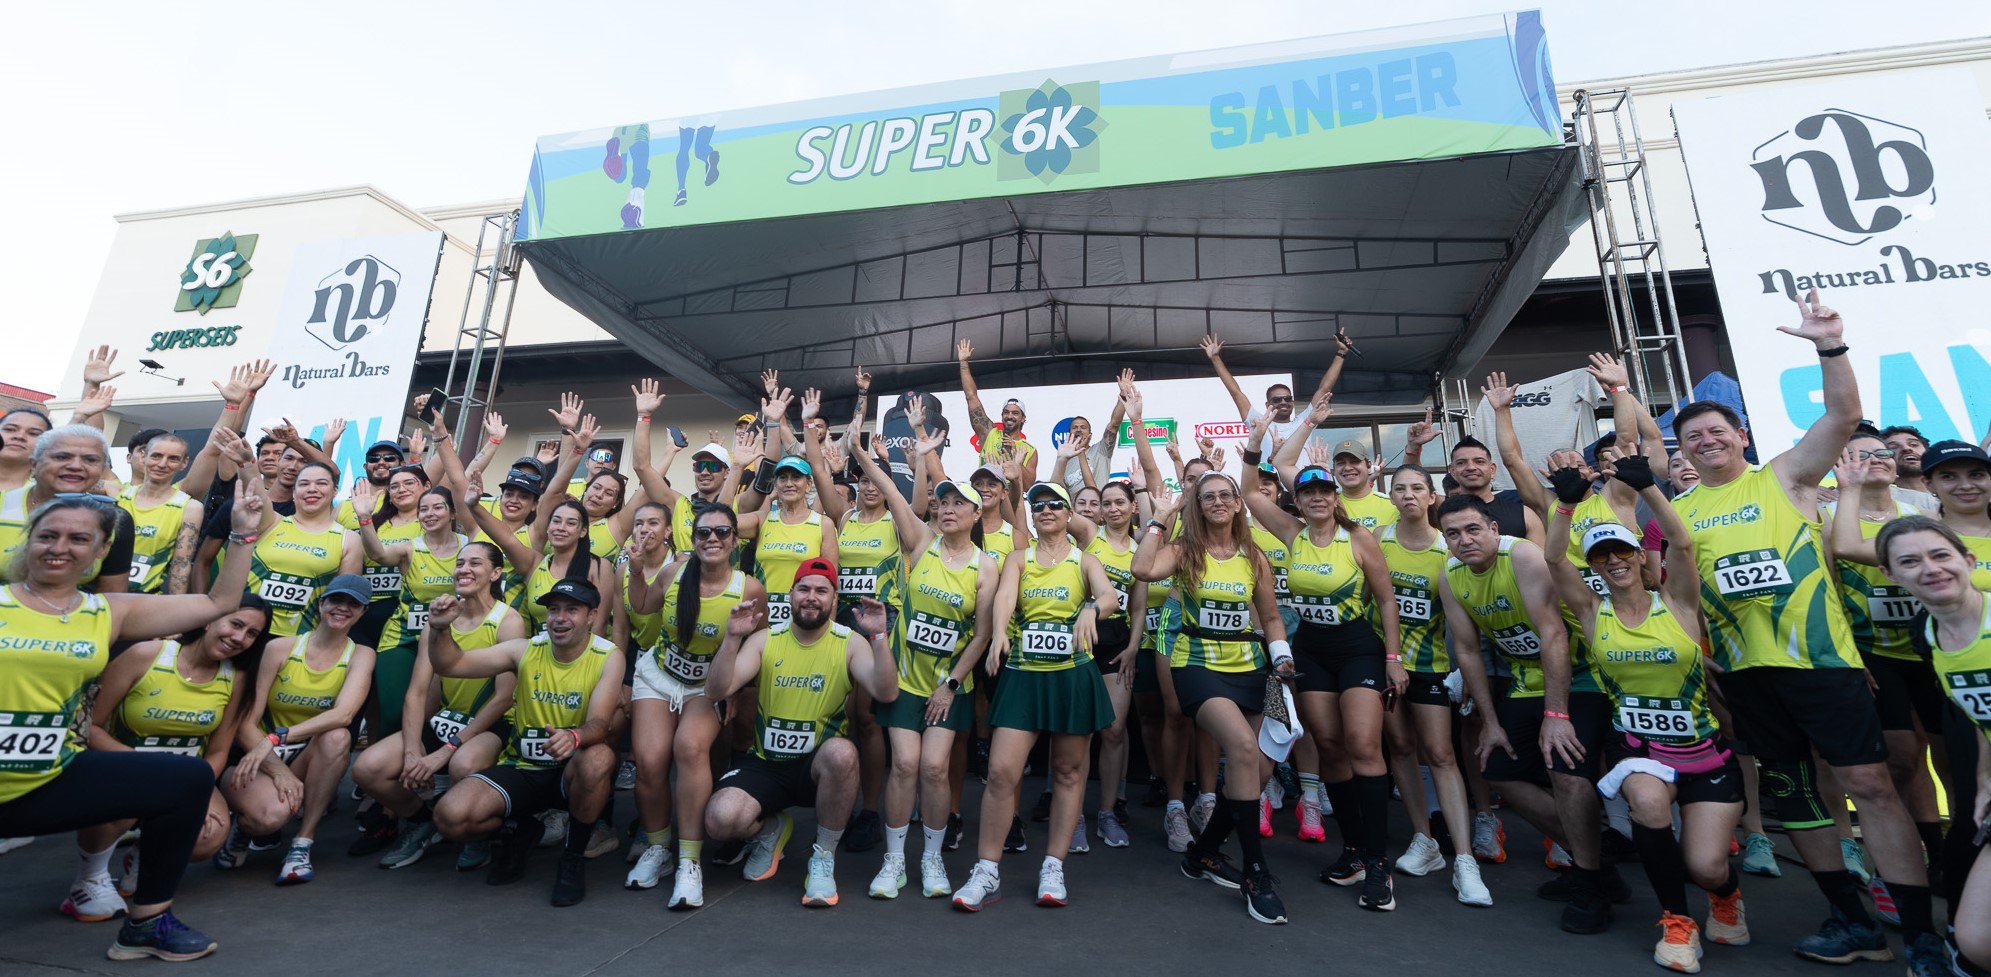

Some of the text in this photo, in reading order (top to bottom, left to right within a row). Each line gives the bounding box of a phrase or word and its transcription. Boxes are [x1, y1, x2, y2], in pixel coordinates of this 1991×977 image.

[1209, 50, 1459, 151] SANBER
[787, 104, 1082, 186] SUPER 6K
[182, 251, 237, 291] S6
[145, 324, 243, 352] SUPERSEIS
[1127, 426, 1168, 439] Cpesino
[1693, 506, 1757, 533] SUPER 6K
[272, 541, 312, 555] SUPER
[762, 541, 807, 552] SUPER 6K
[841, 539, 881, 548] SUPER 6K
[1291, 562, 1331, 574] SUPER 6K
[366, 576, 400, 589] 937
[839, 577, 874, 592] 1444
[1199, 580, 1247, 593] SUPER 6K
[1415, 577, 1427, 586] 6K
[1721, 564, 1783, 593] 1622
[263, 582, 309, 602] 1092
[917, 584, 963, 606] SUPER 6K
[1023, 588, 1069, 599] SUPER 6K
[1396, 598, 1427, 616] 565
[1207, 611, 1243, 627] 1178
[704, 625, 717, 635] 6K
[914, 625, 953, 647] 1207
[0, 635, 95, 656] SUPER 6K
[1027, 634, 1068, 651] 1206
[1500, 636, 1539, 653] 1566
[1606, 650, 1672, 662] SUPER 6K
[667, 653, 704, 678] 1256
[775, 676, 824, 689] SUPER 6K
[275, 692, 317, 708] SUPER
[531, 688, 580, 706] SUPER 6K
[143, 706, 217, 725] SUPER 6K
[1625, 711, 1689, 733] 1586
[433, 719, 460, 739] 138
[526, 741, 546, 758] 15
[769, 731, 810, 751] 1627
